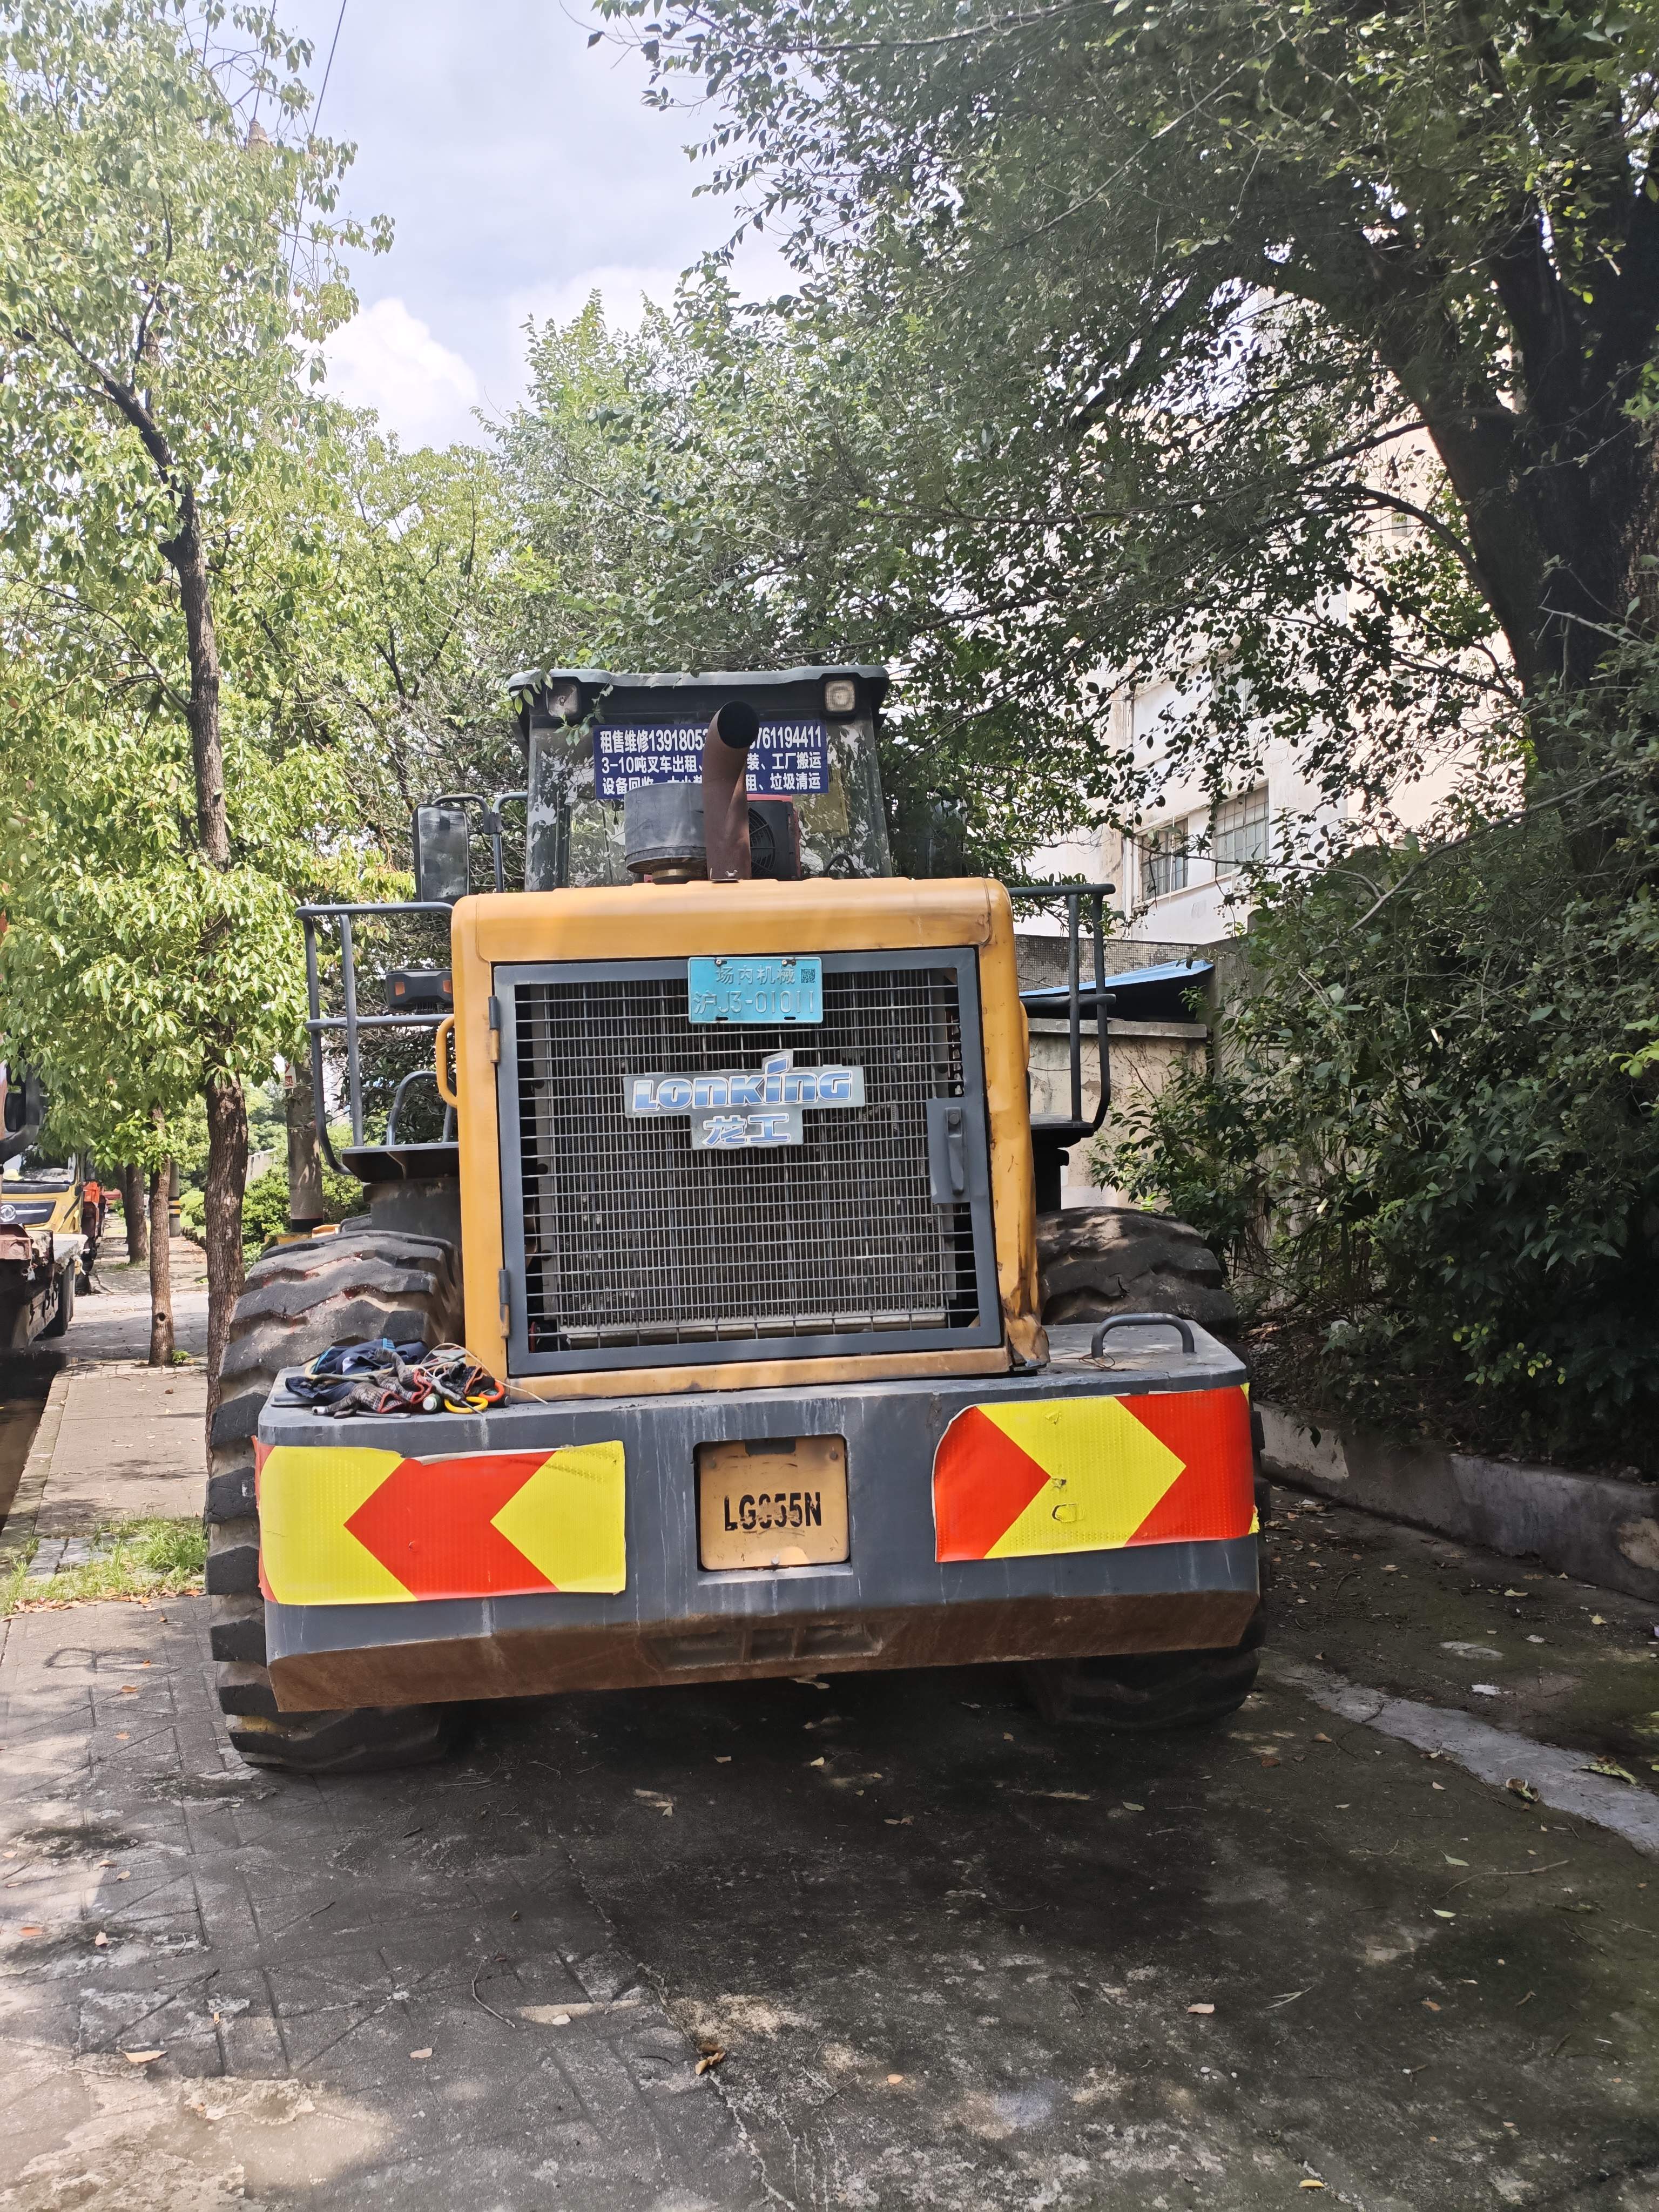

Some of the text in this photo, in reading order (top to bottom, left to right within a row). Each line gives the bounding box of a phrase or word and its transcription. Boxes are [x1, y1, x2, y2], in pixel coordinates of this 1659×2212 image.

[749, 725, 821, 750] 761194411
[716, 965, 795, 985] 场内机械
[702, 1112, 791, 1146] 龙工
